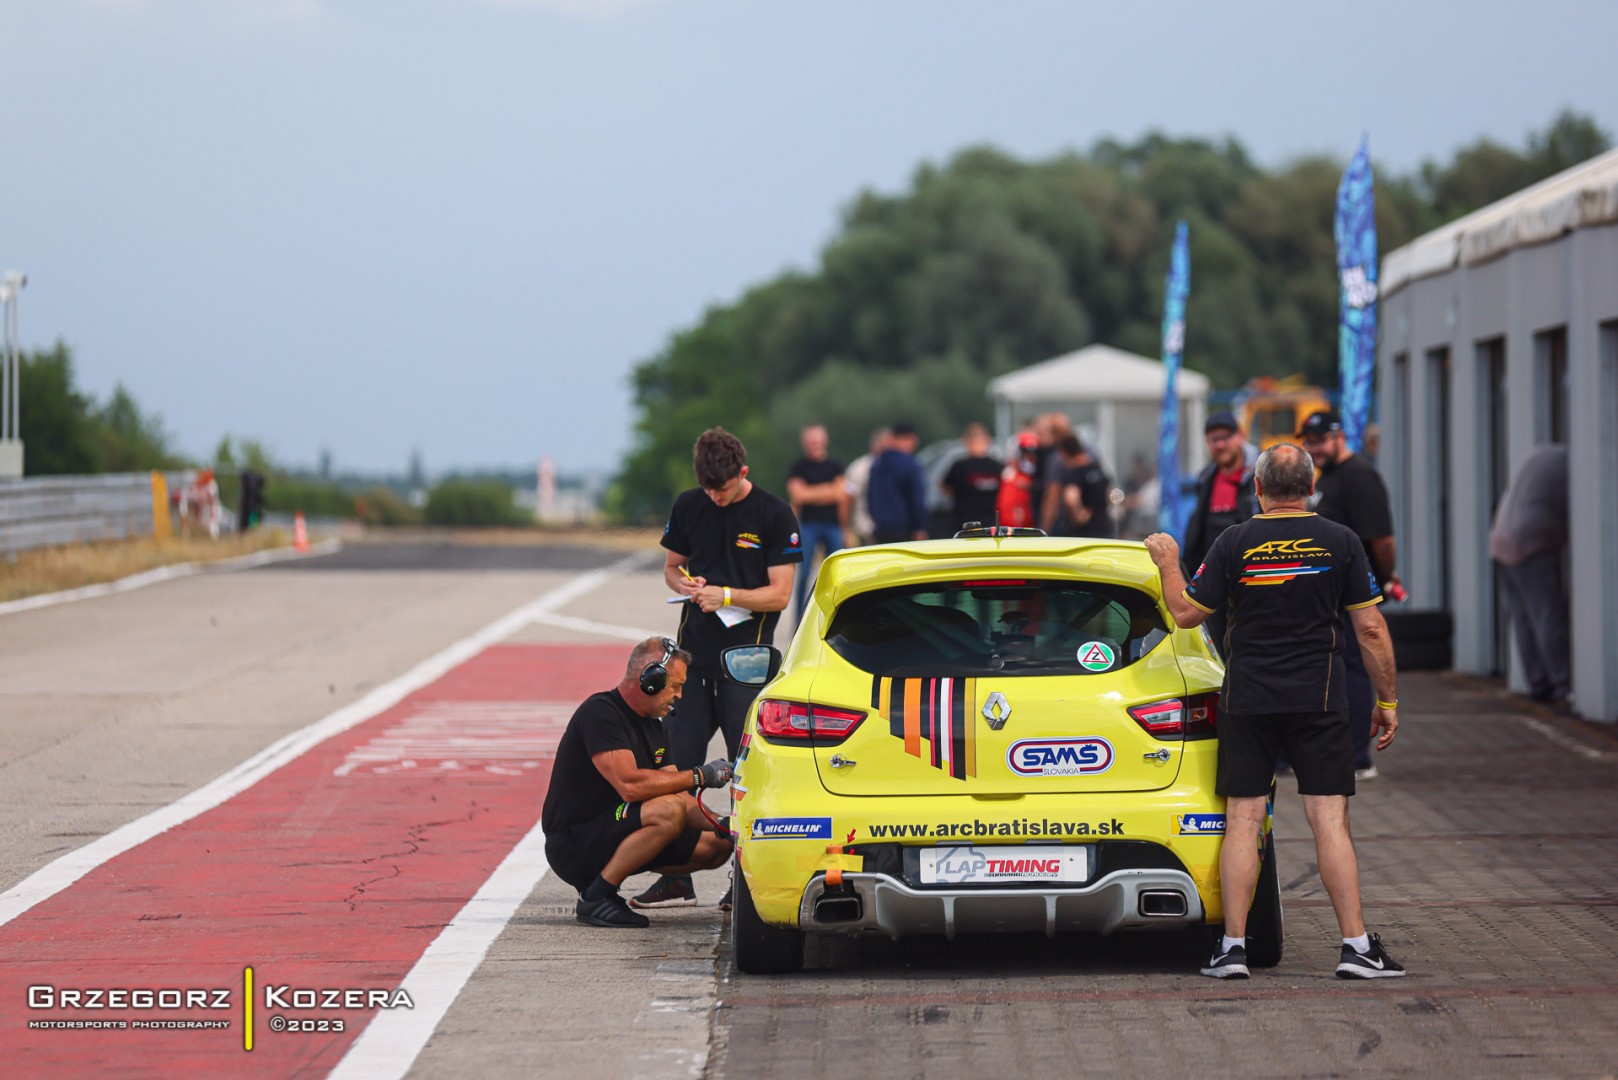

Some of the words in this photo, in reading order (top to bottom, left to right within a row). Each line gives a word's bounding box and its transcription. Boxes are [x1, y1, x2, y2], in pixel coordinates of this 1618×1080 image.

[1252, 552, 1332, 560] BRATISLAVA
[1091, 651, 1101, 661] Z
[1023, 744, 1098, 766] SAMŠ
[1043, 767, 1080, 775] SLOVAKIA
[764, 824, 821, 833] MICHELIN
[868, 818, 1124, 837] www.arcbratislava.sk
